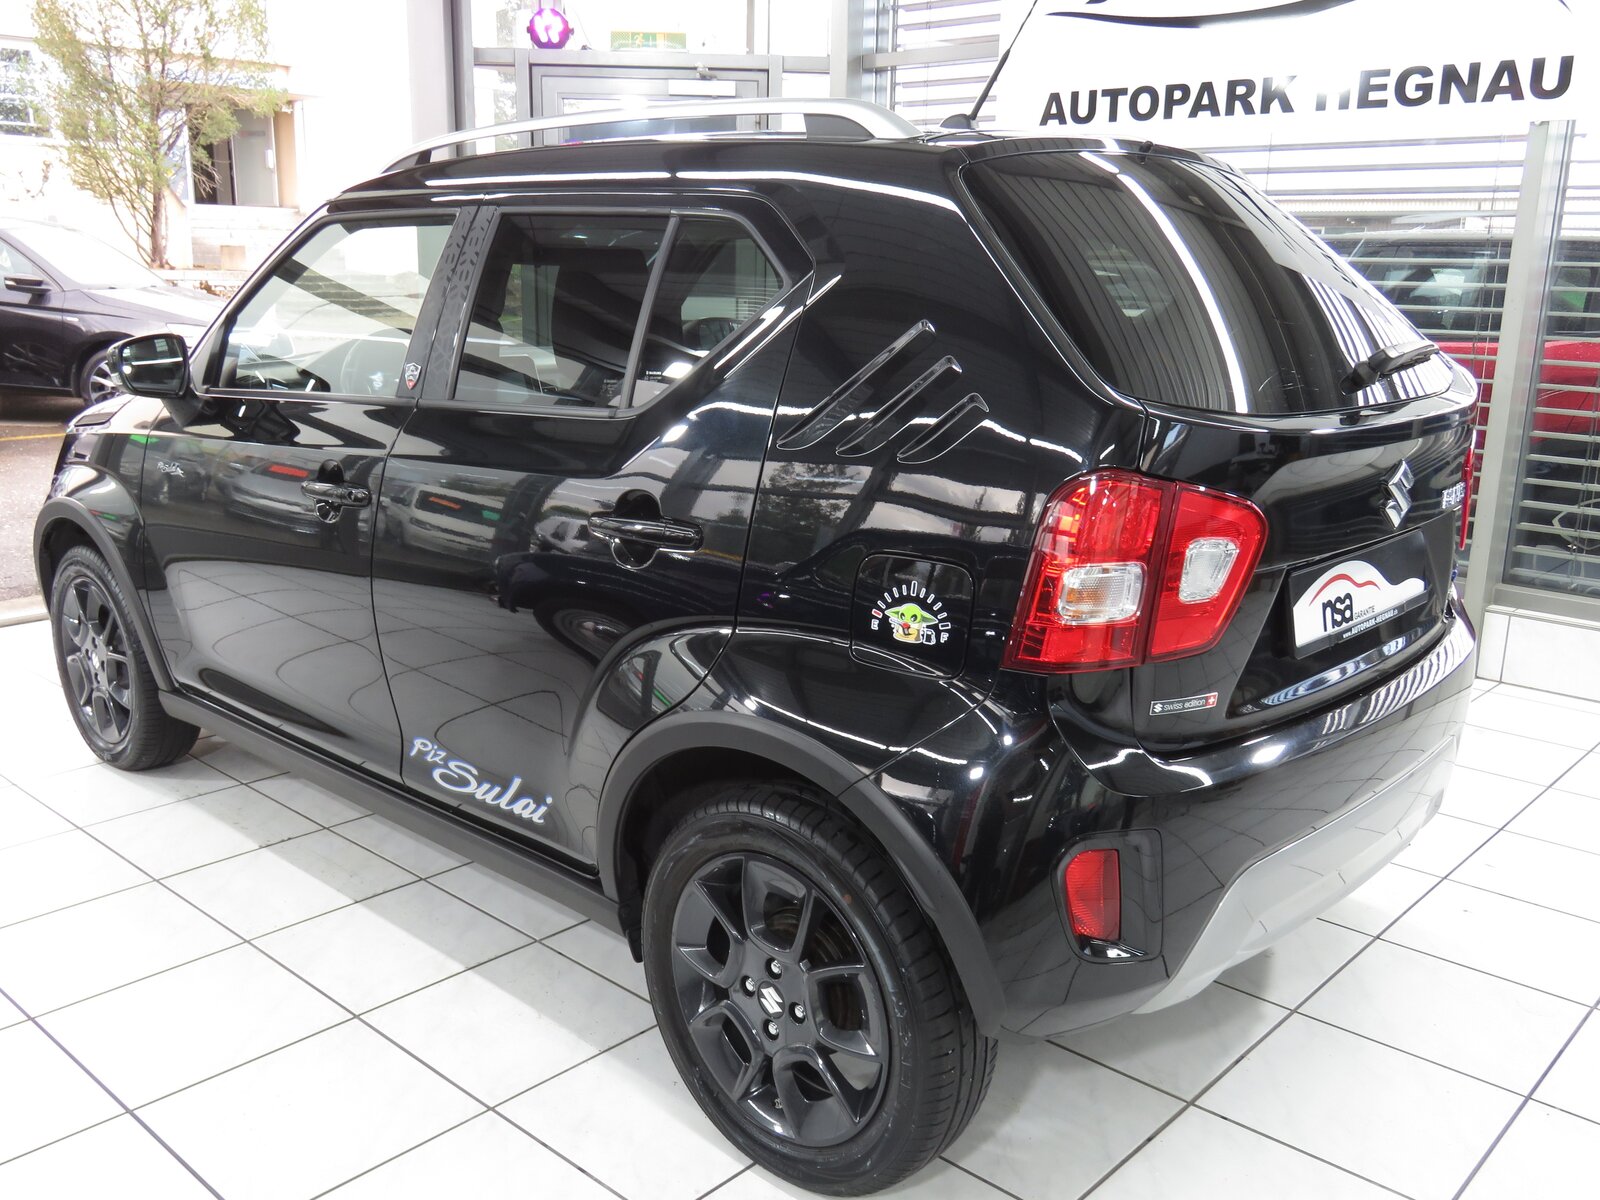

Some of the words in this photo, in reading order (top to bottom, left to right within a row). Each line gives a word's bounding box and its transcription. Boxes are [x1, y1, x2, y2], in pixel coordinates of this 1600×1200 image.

[1039, 75, 1297, 126] AUTOPARK
[1322, 592, 1354, 632] nsa
[410, 738, 447, 764] Piz
[432, 760, 553, 824] Sulai
